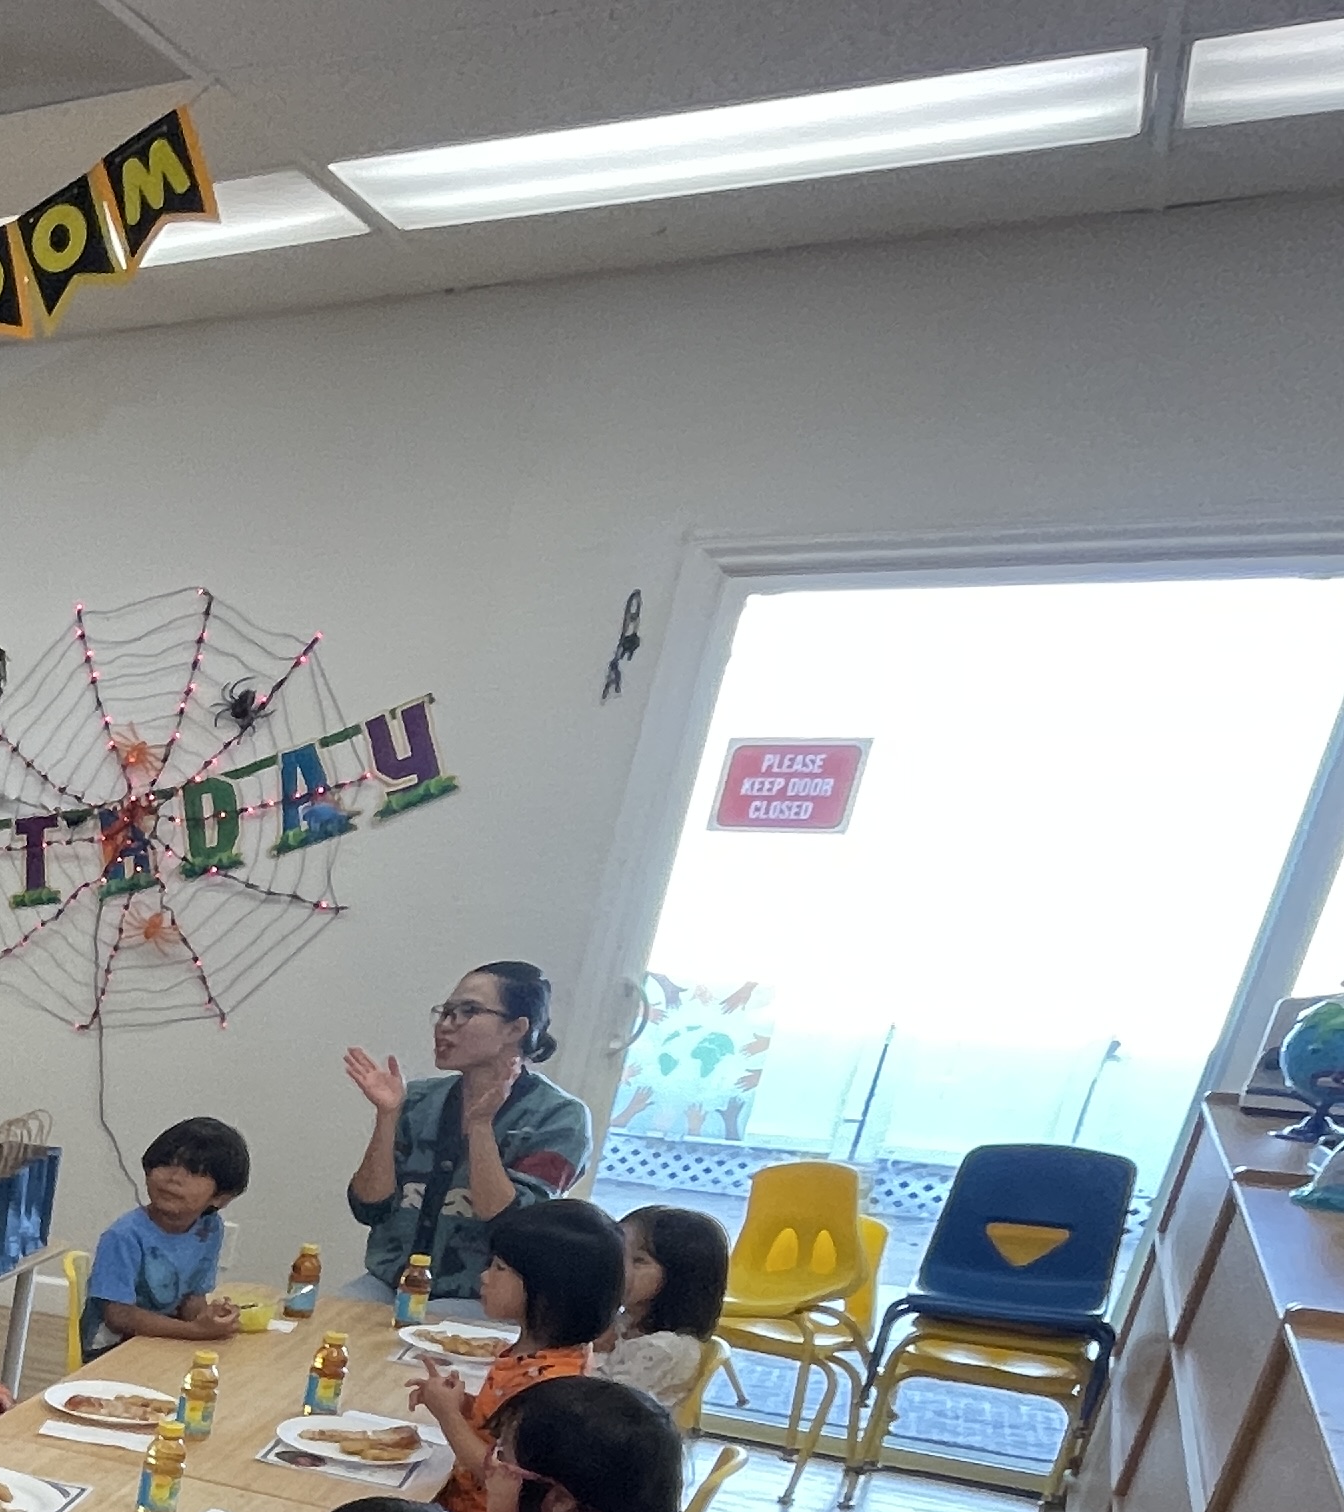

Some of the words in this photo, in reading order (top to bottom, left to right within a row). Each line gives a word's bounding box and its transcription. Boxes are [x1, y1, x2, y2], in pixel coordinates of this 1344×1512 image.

[760, 754, 827, 774] PLEASE
[740, 778, 786, 796] KEEP
[787, 778, 835, 797] DOOR
[748, 801, 814, 820] CLOSED
